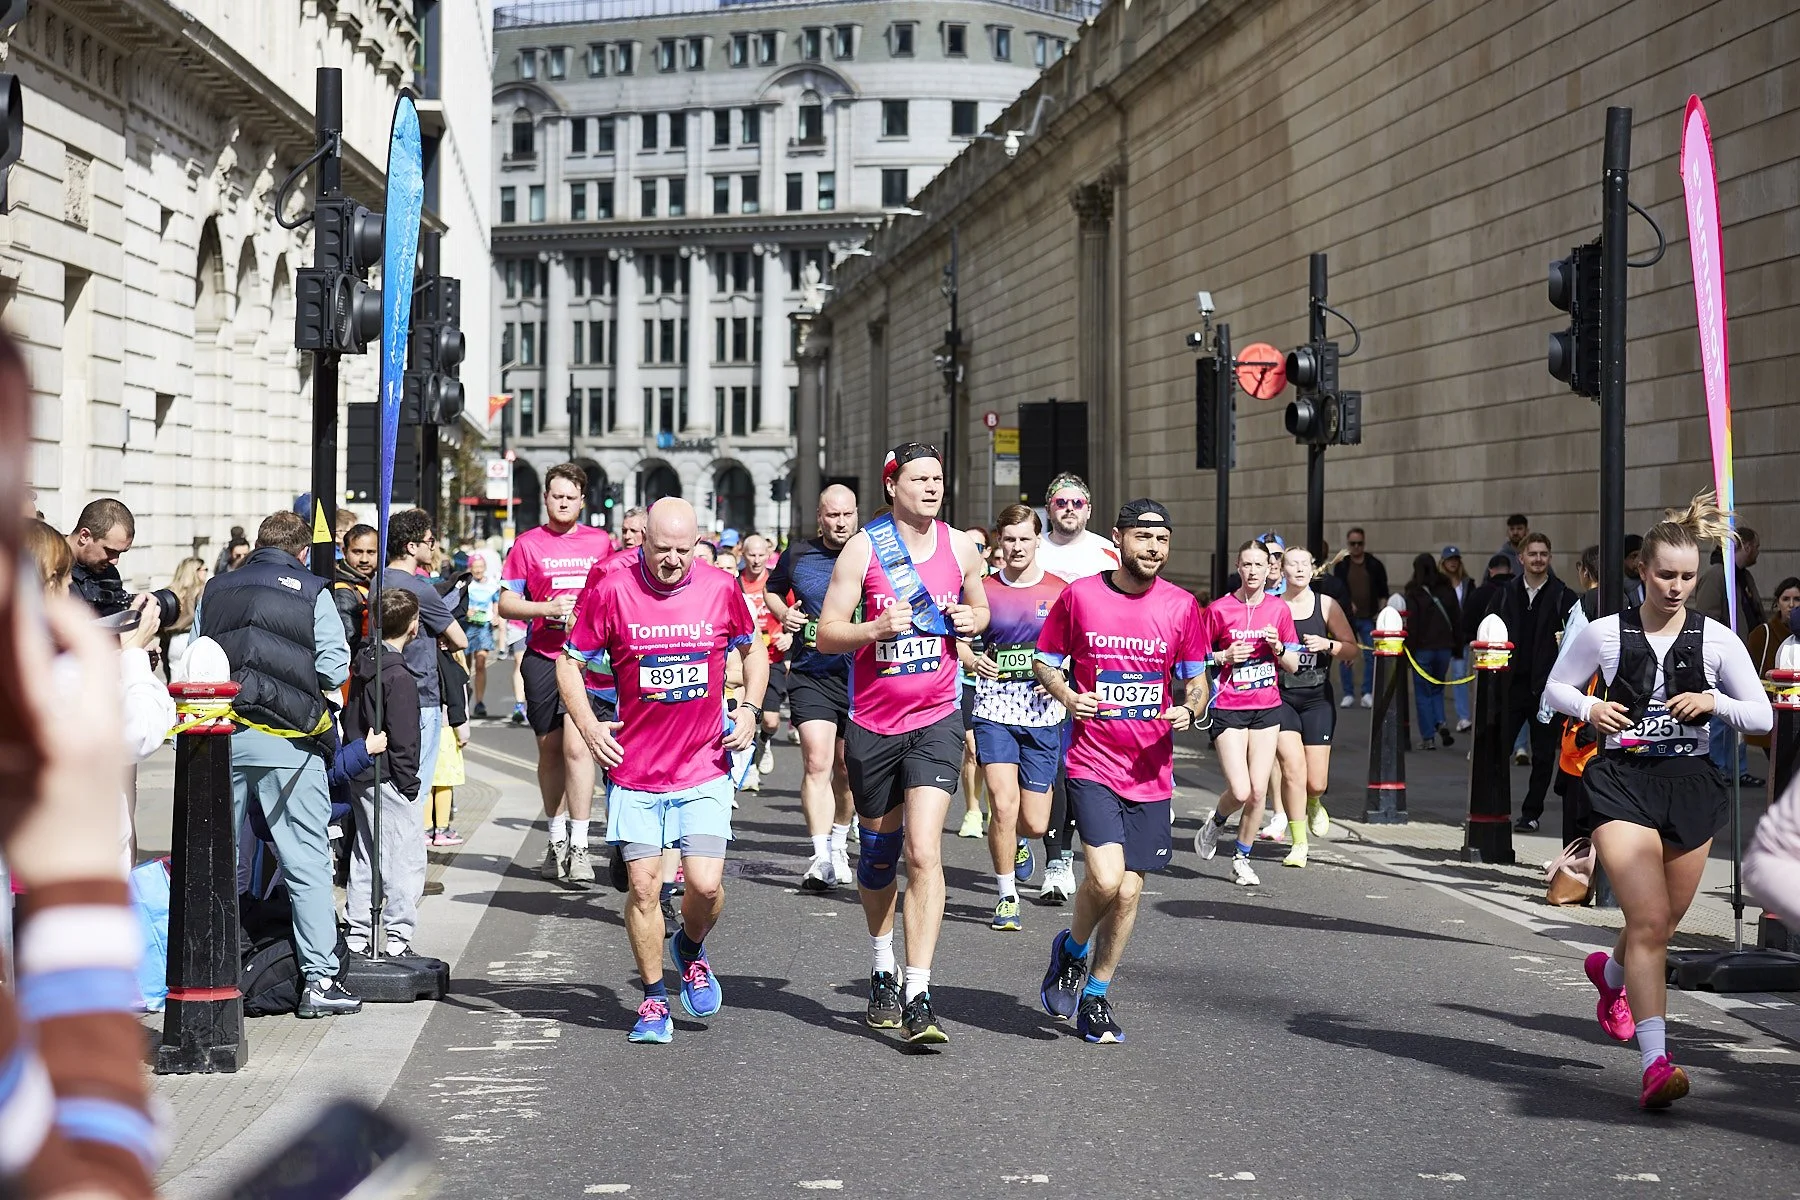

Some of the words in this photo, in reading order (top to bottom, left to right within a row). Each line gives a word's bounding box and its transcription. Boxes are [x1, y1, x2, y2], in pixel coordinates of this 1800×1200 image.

[873, 591, 959, 611] Toy's
[628, 620, 714, 640] Tommy's
[1228, 628, 1267, 640] Tomm
[879, 638, 937, 660] 11417
[1085, 632, 1168, 655] Tommy's
[657, 654, 691, 663] NICHOLAS
[1299, 653, 1315, 665] 07
[650, 666, 699, 686] 8912
[1235, 664, 1273, 681] 11789
[1102, 685, 1160, 702] 10375
